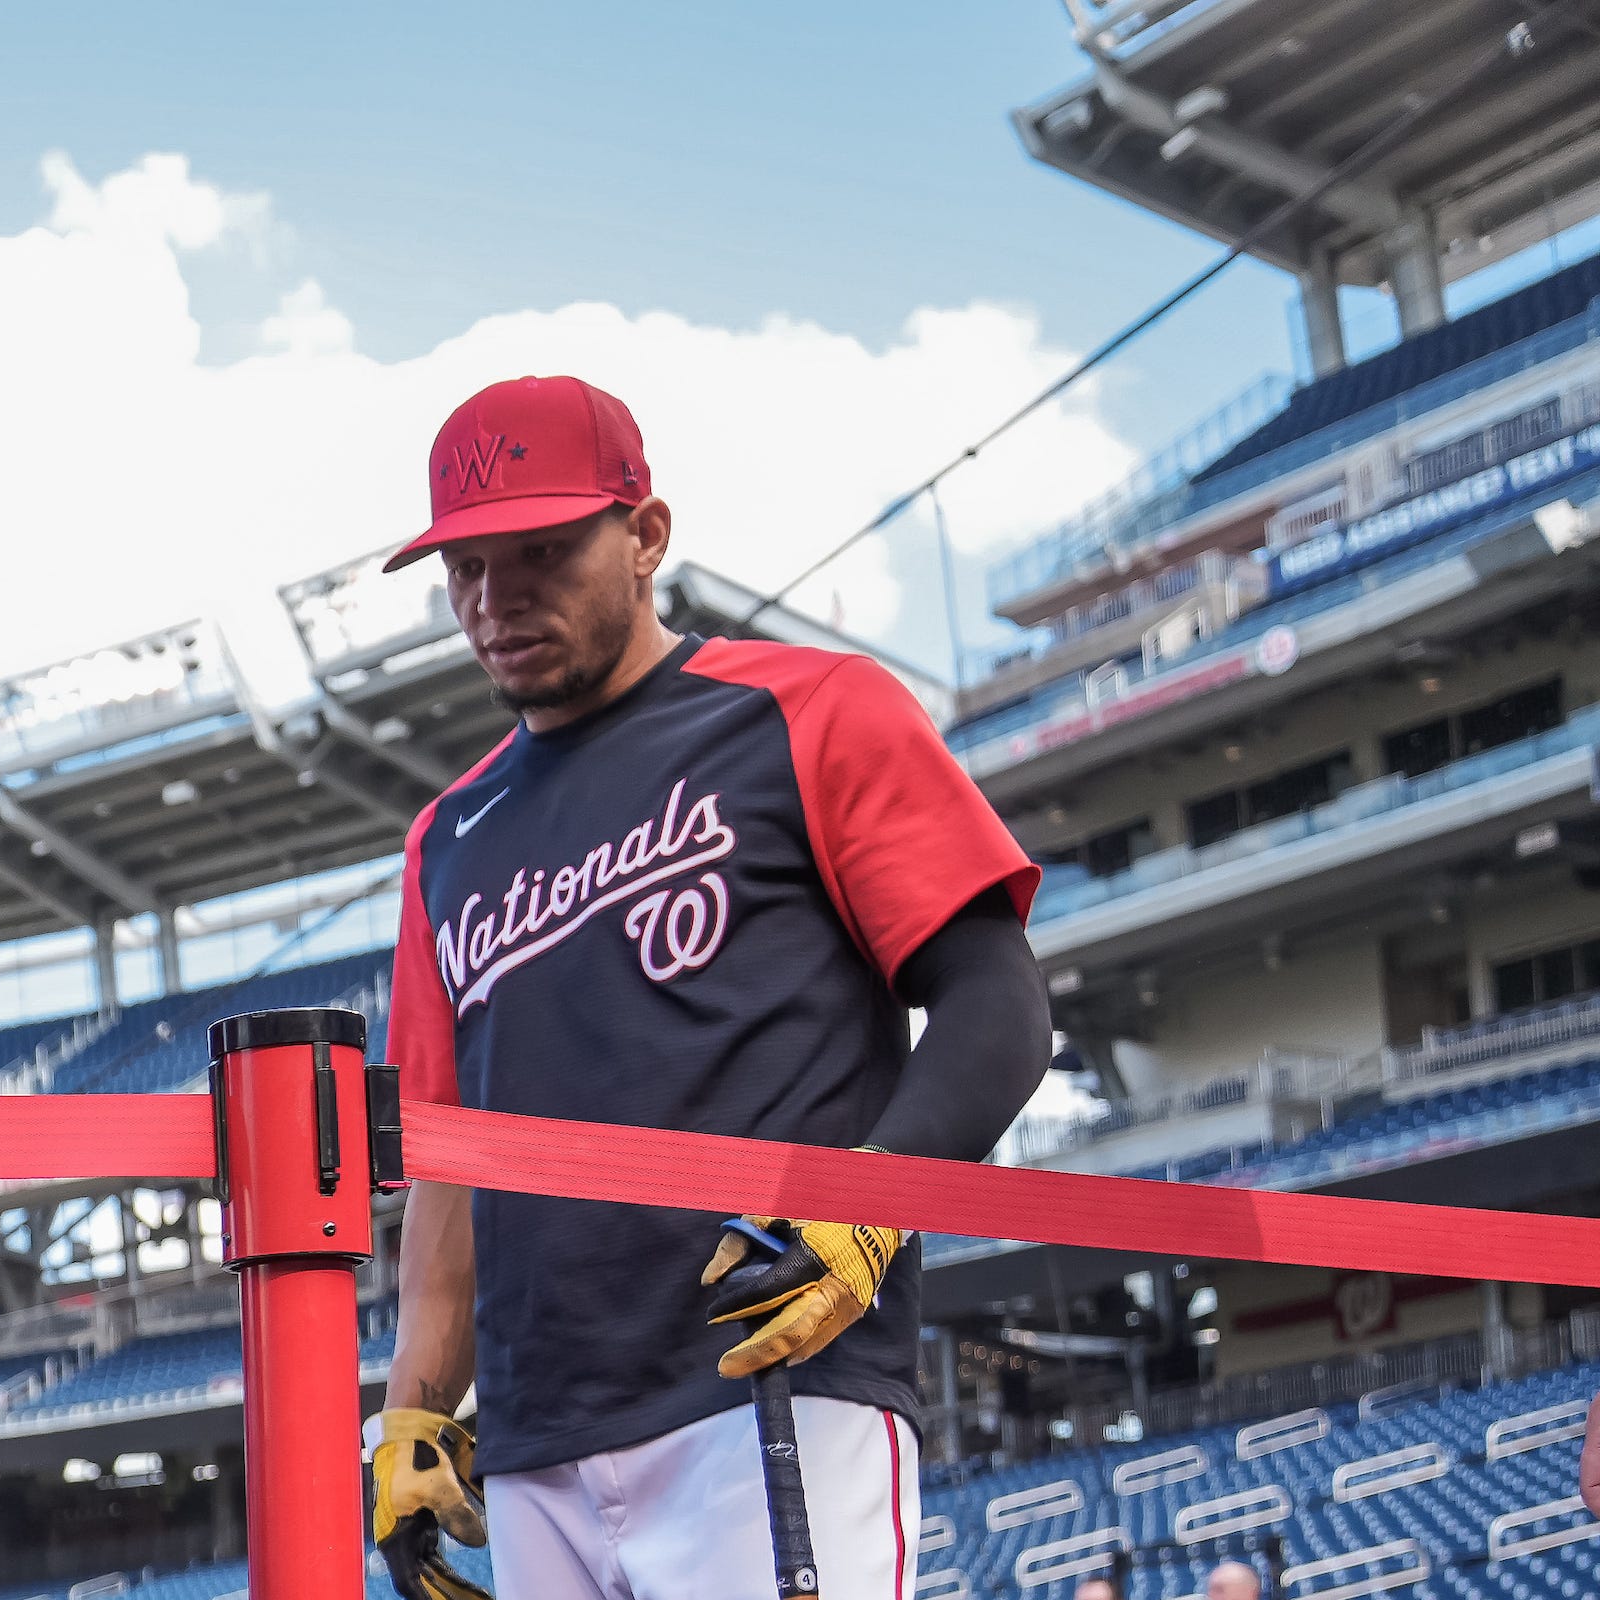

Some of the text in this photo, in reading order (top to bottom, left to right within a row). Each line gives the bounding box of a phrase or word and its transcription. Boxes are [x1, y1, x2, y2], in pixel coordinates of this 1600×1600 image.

[453, 434, 506, 494] W
[436, 776, 737, 1018] Nationals
[624, 871, 730, 983] W
